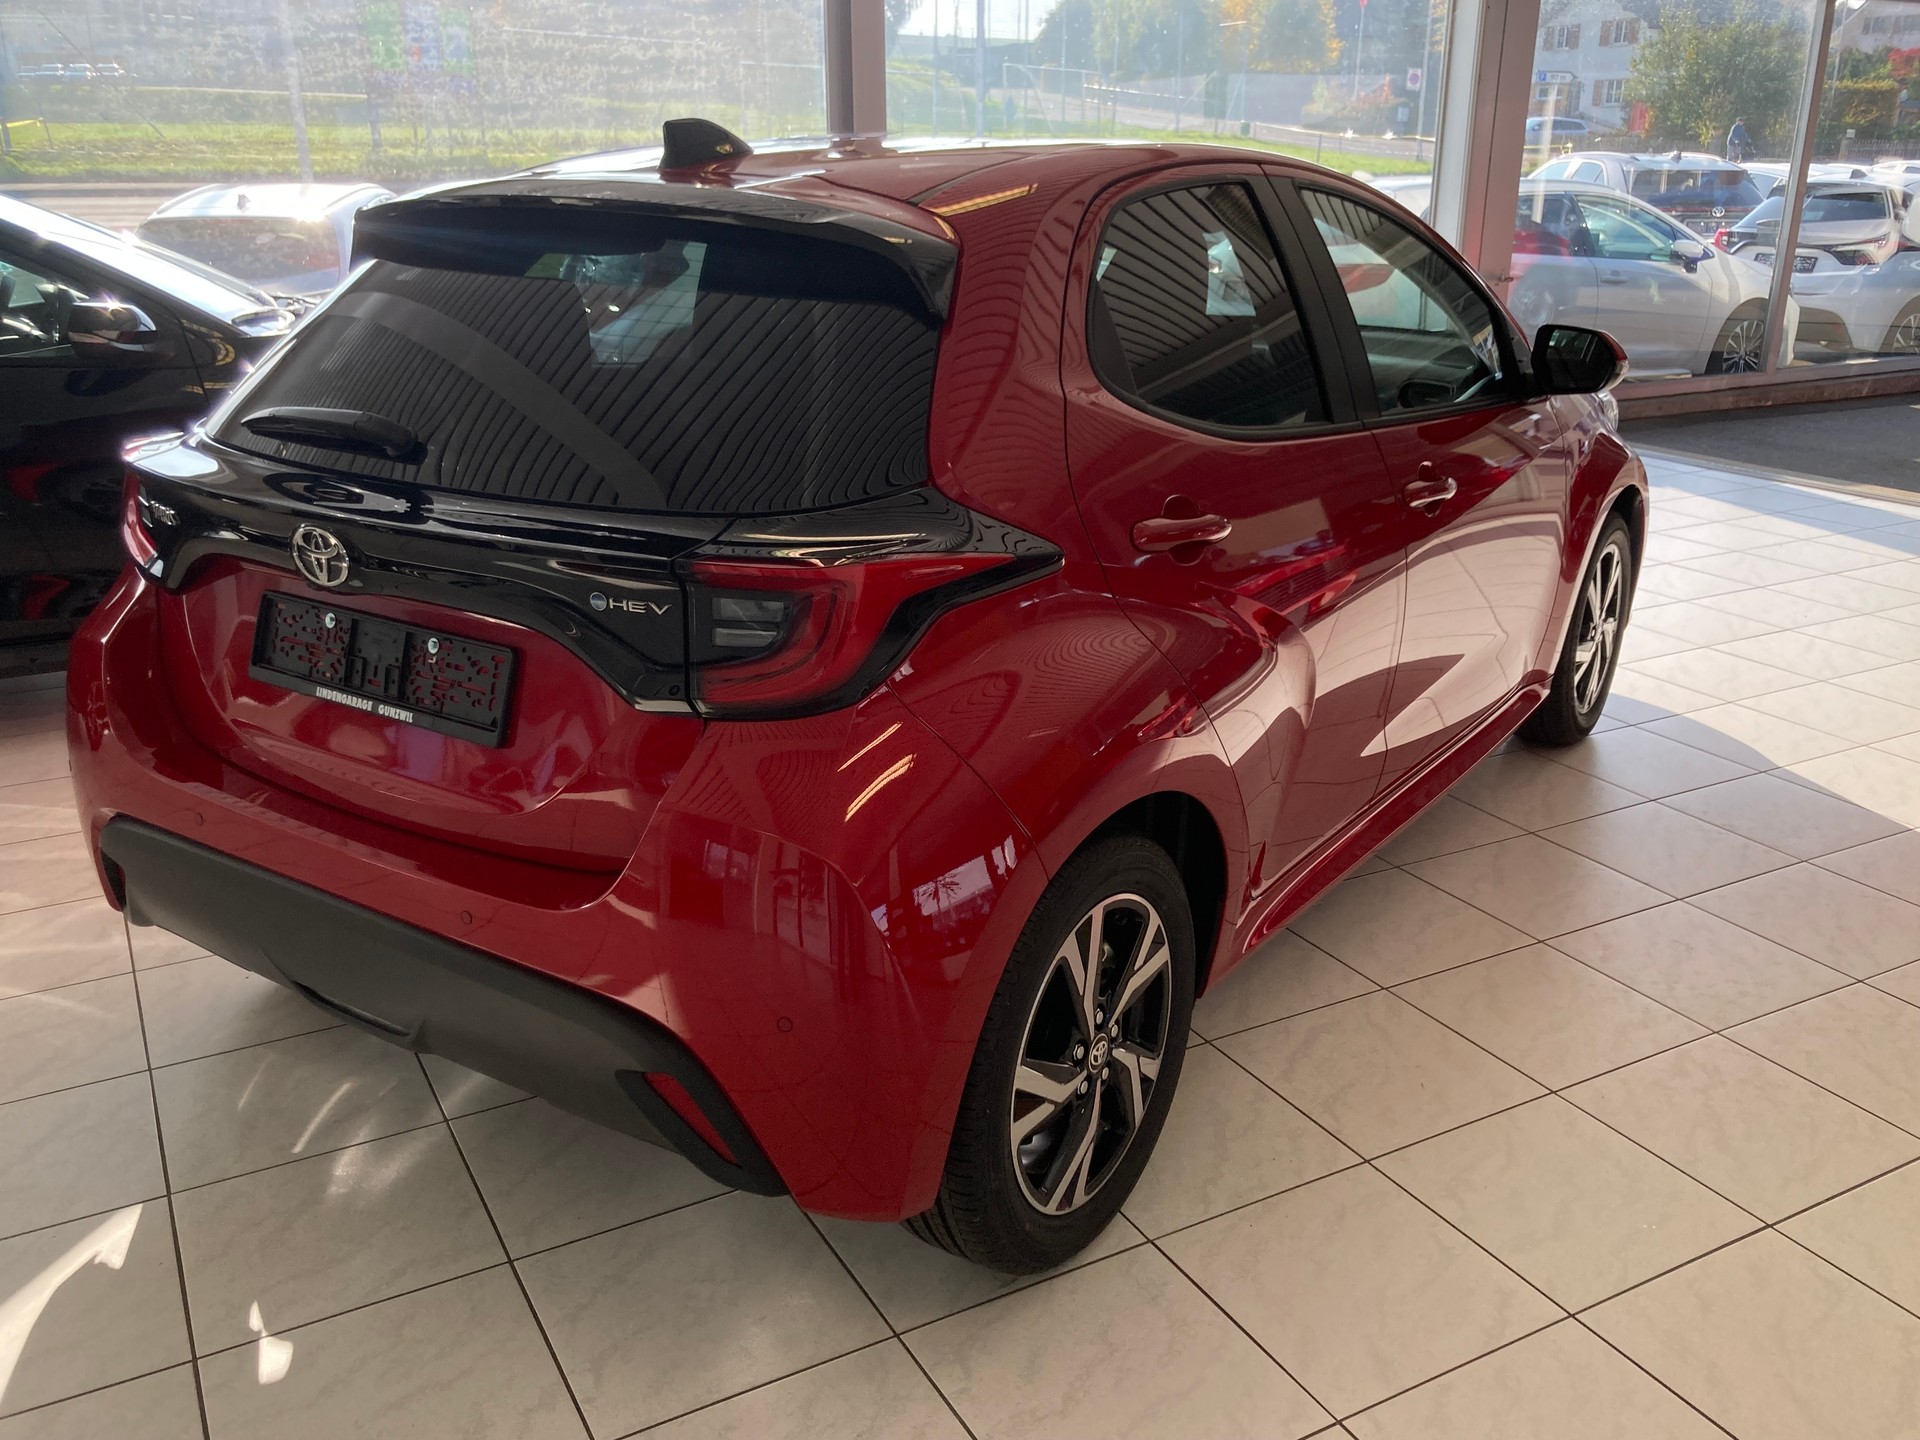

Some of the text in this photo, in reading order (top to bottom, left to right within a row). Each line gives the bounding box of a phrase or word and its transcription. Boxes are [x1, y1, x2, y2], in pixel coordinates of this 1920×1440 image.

[609, 597, 672, 615] HEV
[316, 686, 413, 723] LINDENGARAGE GUNZWIL
